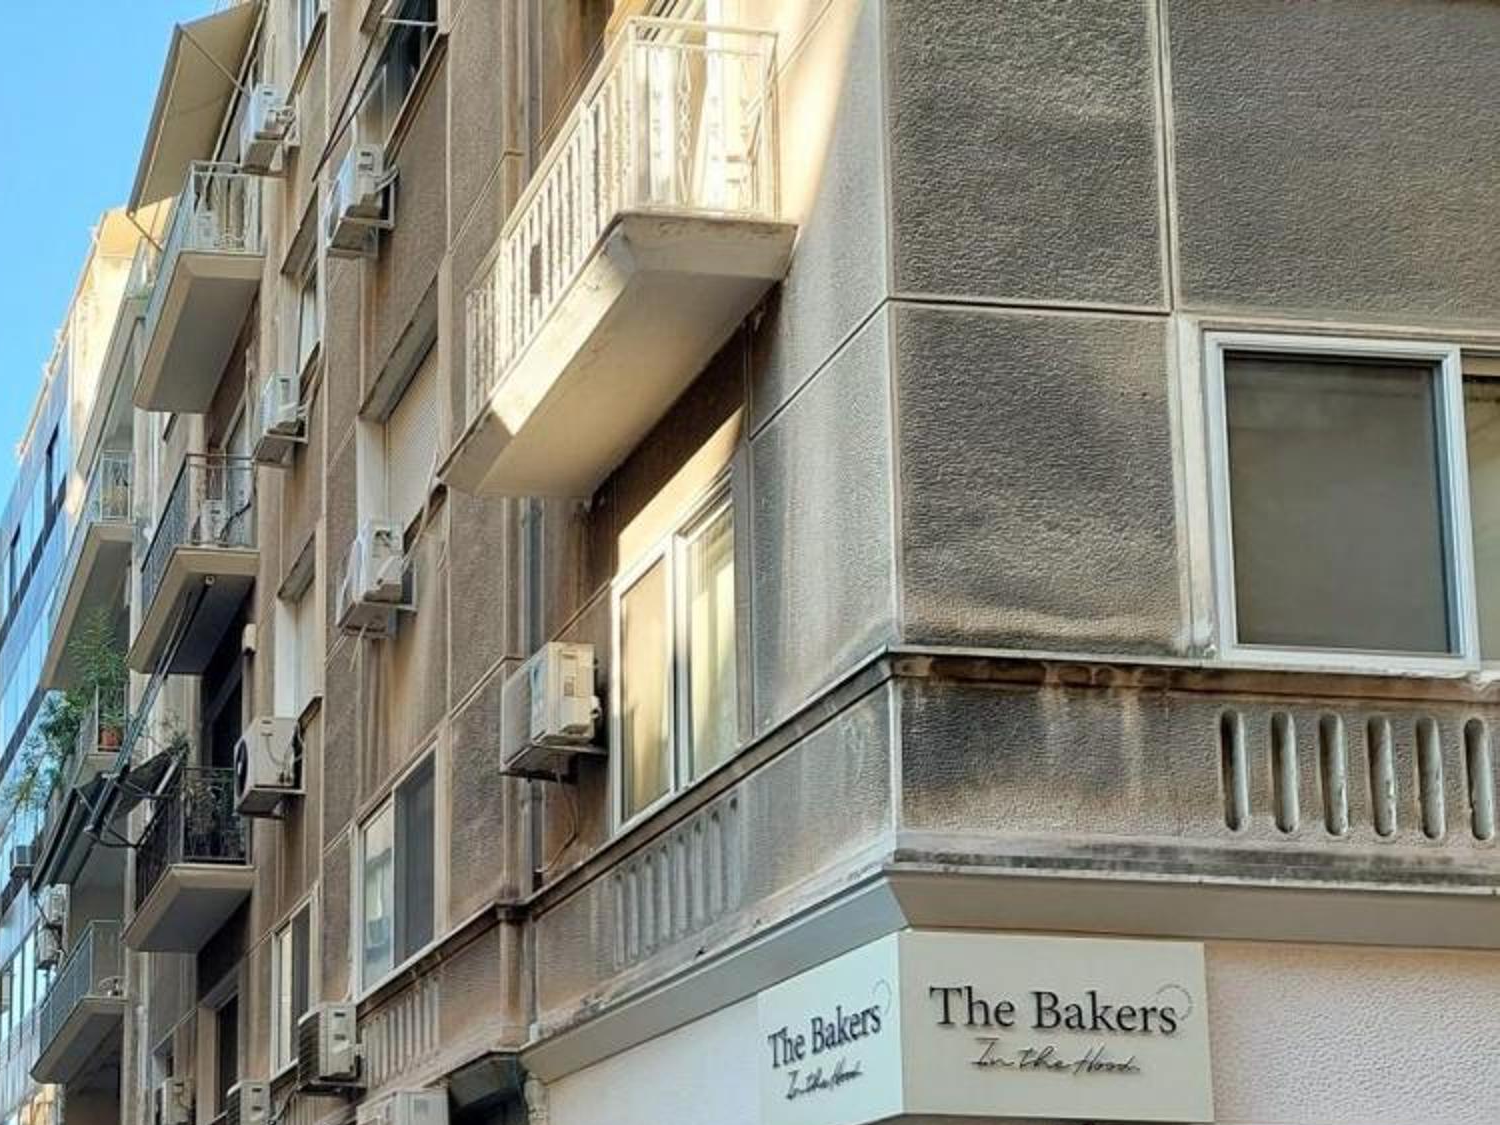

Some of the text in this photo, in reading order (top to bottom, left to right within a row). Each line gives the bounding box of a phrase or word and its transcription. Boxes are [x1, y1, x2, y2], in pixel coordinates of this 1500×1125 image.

[929, 985, 1015, 1028] The
[1030, 990, 1177, 1035] Bakers
[768, 1005, 881, 1069] The Bakers
[970, 1038, 1140, 1076] In the Hood
